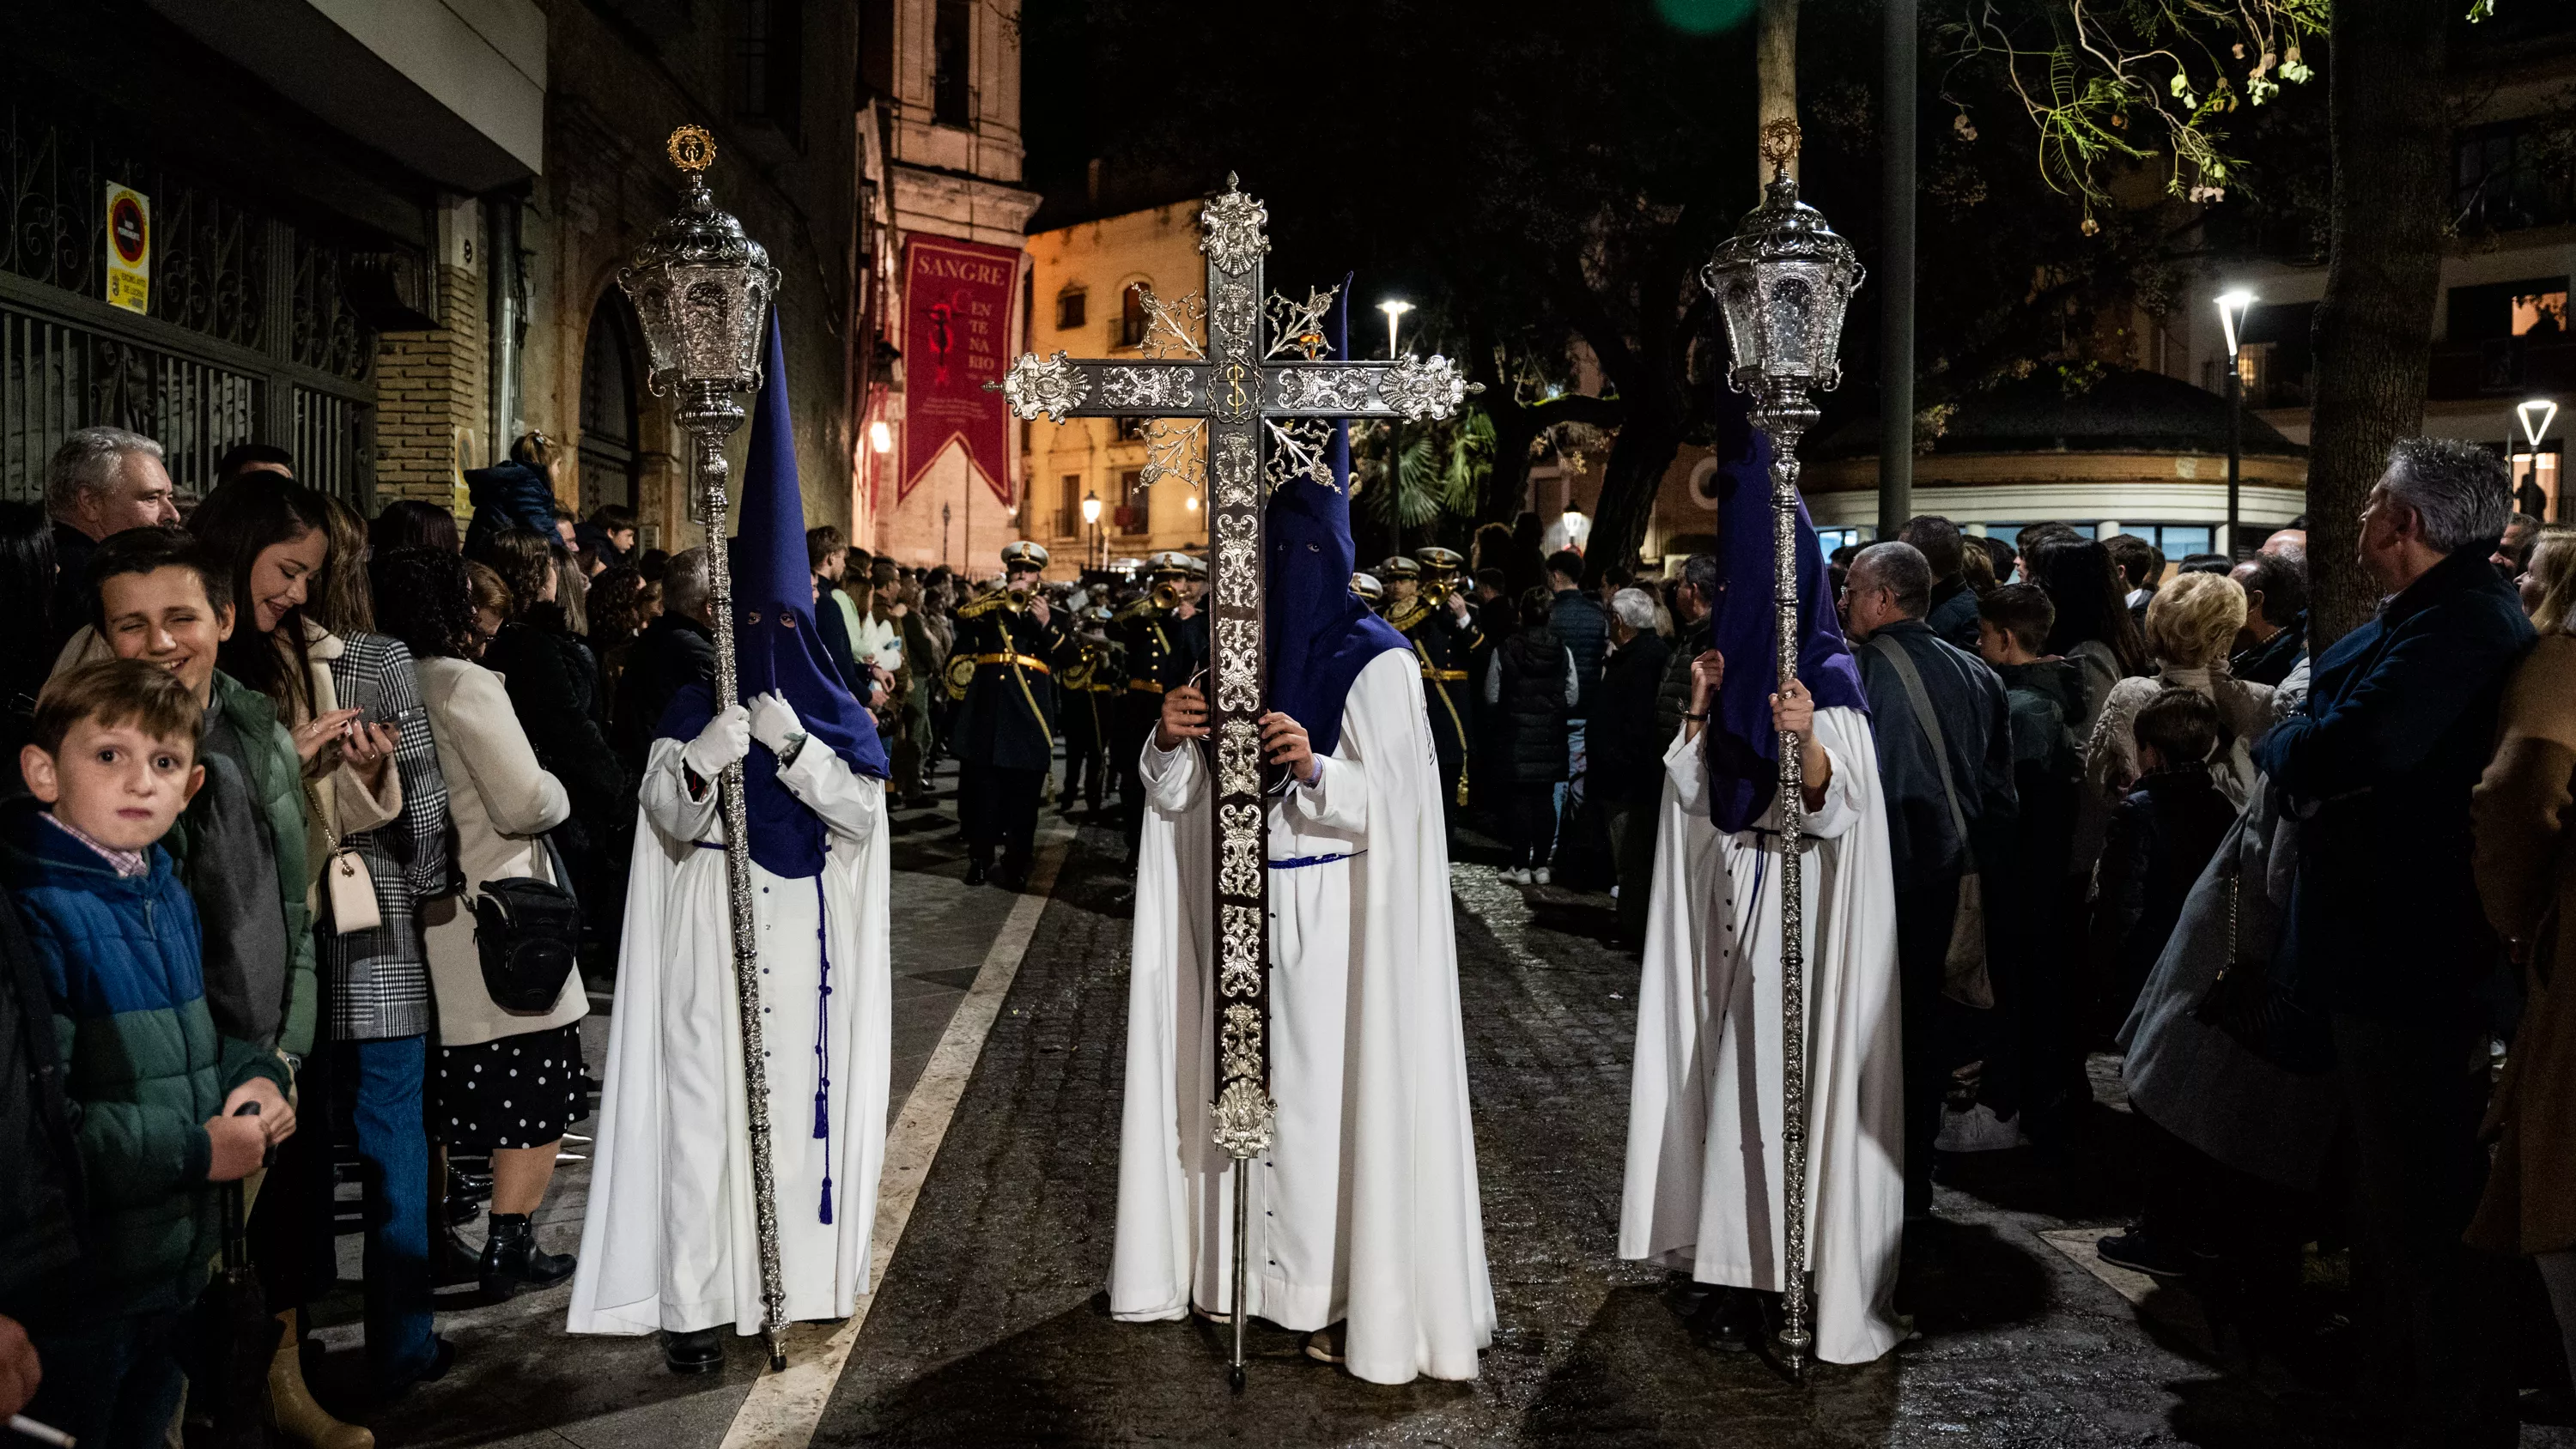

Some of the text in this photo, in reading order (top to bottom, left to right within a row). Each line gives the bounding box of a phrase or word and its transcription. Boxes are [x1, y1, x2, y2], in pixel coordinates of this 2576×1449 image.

[917, 256, 1007, 288] SANGRE
[971, 300, 992, 317] EN
[969, 318, 989, 335] TE
[968, 336, 990, 354] NA
[968, 355, 995, 371] RIO
